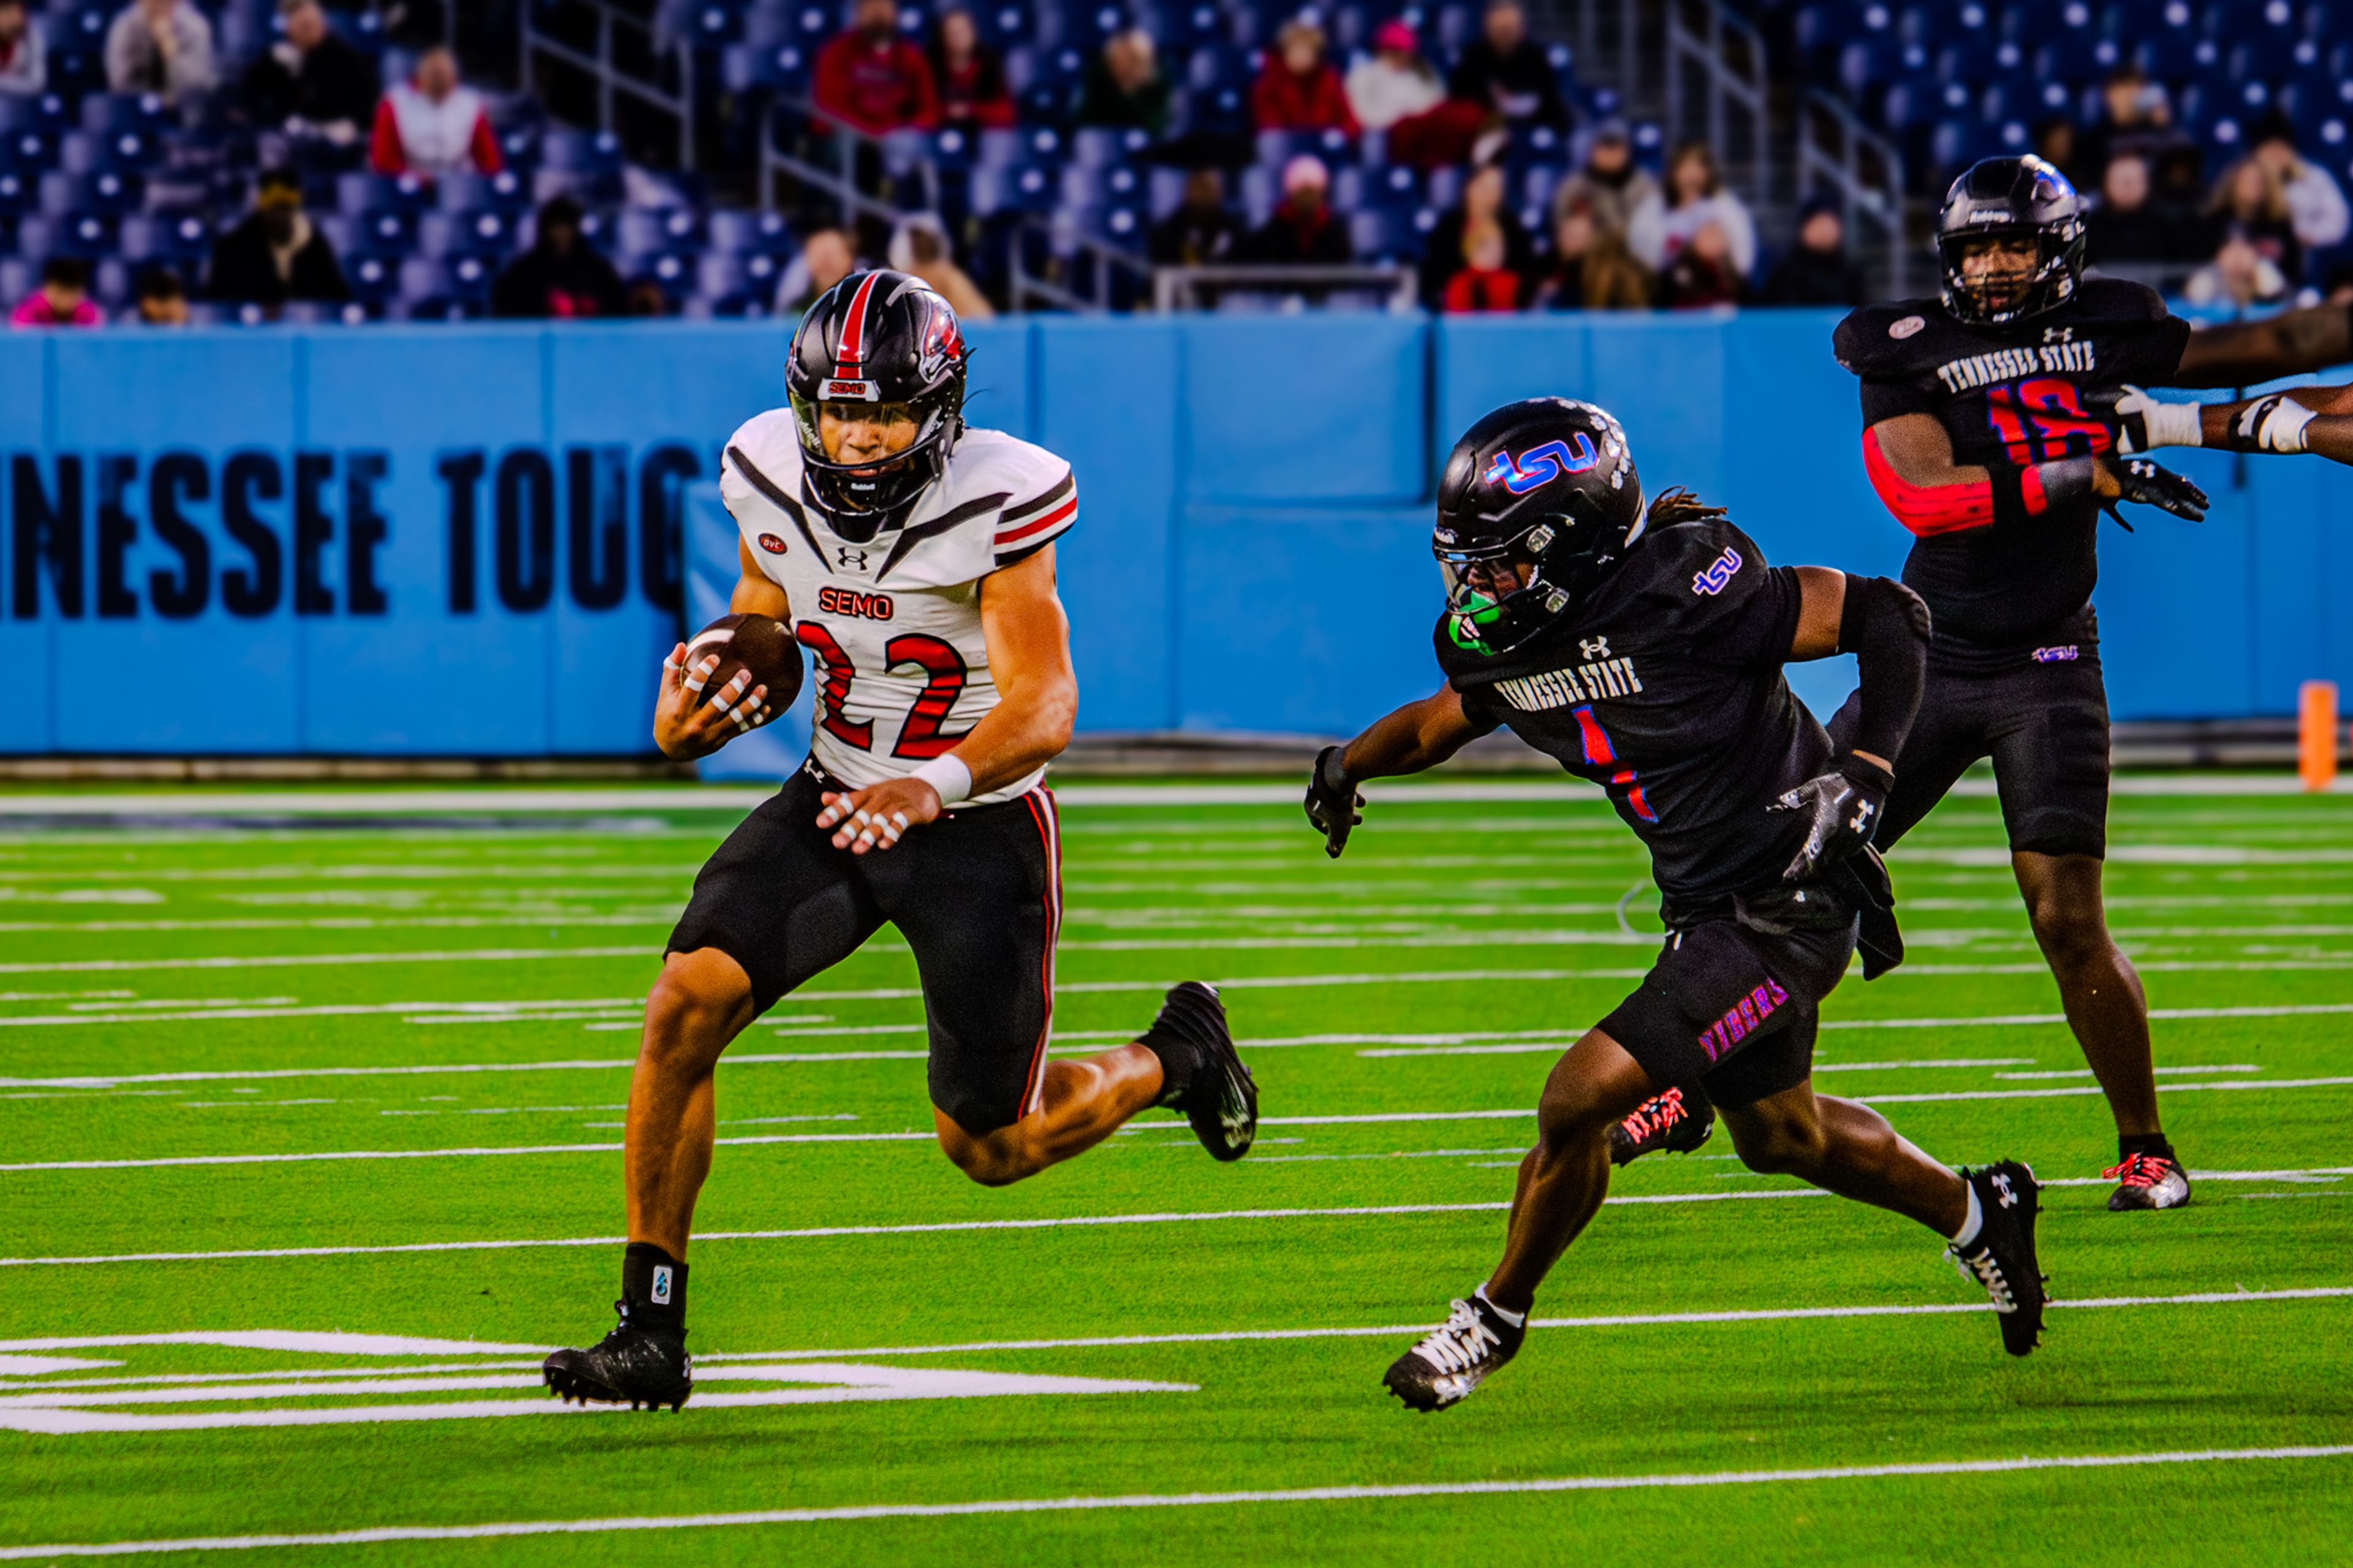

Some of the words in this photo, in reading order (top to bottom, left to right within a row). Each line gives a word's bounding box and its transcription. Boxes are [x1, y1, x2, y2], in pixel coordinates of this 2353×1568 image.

[829, 381, 866, 395] SEMO
[1937, 347, 2038, 393] TENNESSEE
[2039, 341, 2095, 371] STATE
[819, 586, 894, 621] SEMO
[796, 619, 979, 760] 22
[1578, 657, 1643, 700] STATE
[1697, 977, 1789, 1062] TIGERS
